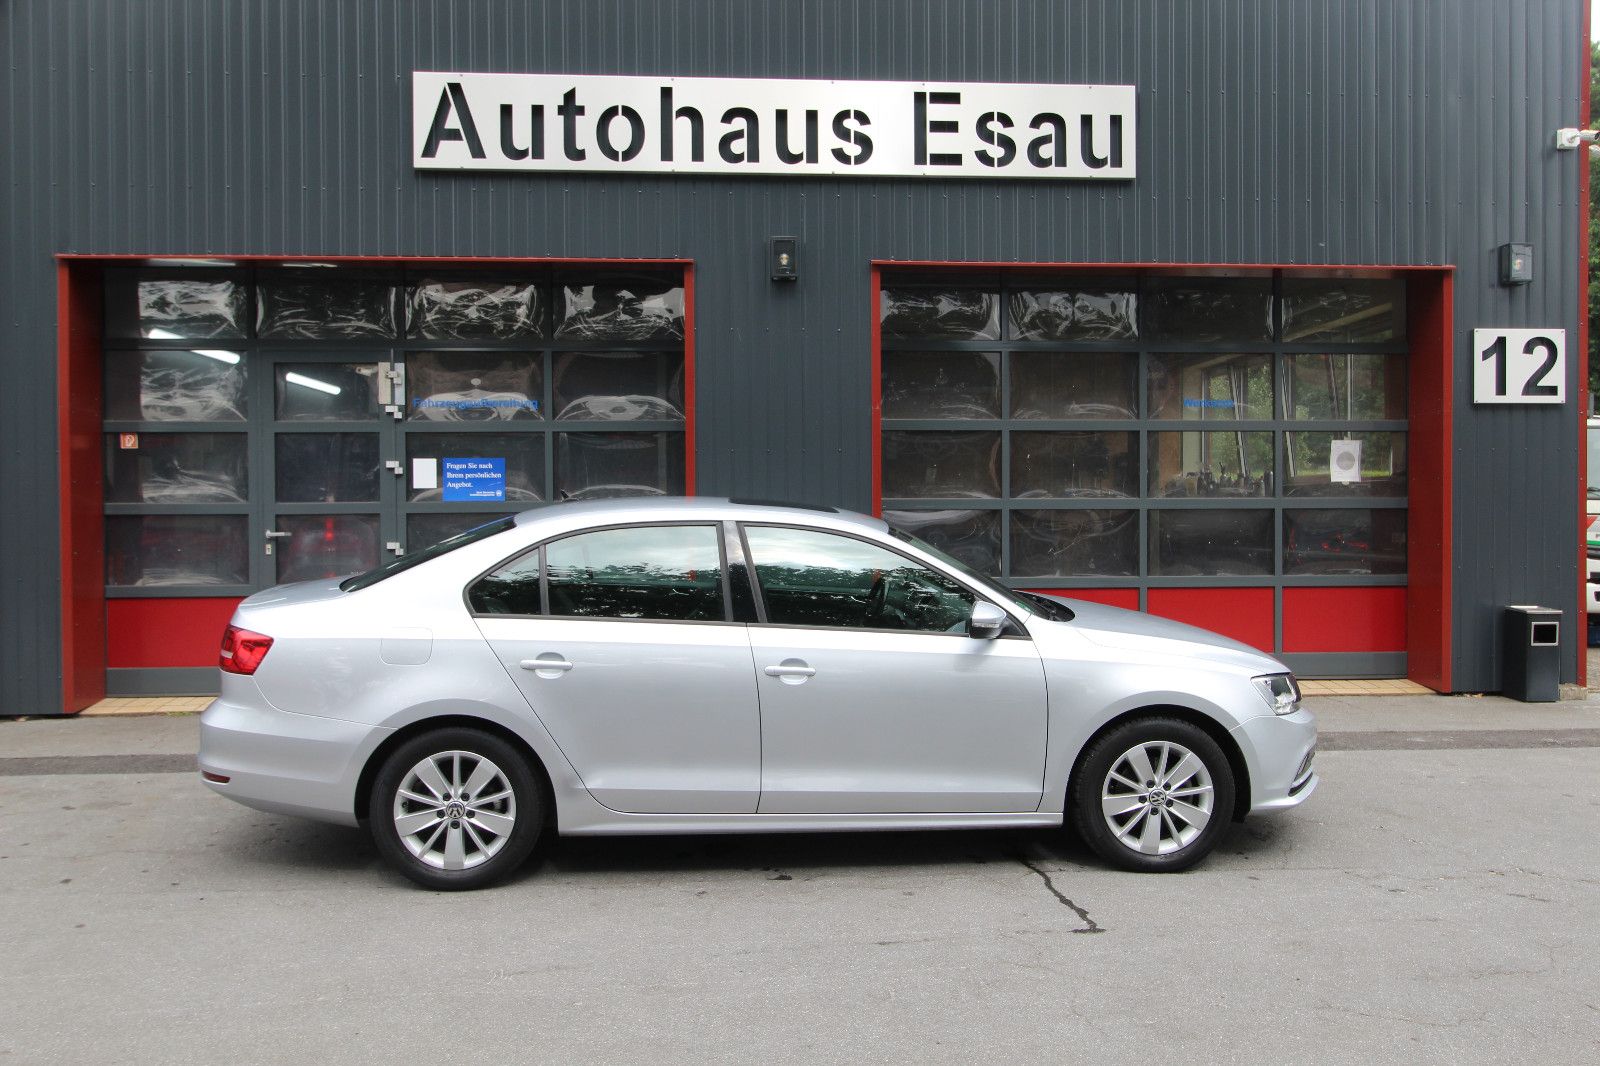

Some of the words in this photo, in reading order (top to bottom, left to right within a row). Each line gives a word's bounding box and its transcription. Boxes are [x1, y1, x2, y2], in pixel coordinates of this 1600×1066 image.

[420, 82, 874, 166] Autohaus
[913, 91, 1123, 169] Esau
[1481, 336, 1559, 396] 12
[446, 462, 467, 470] Fragen
